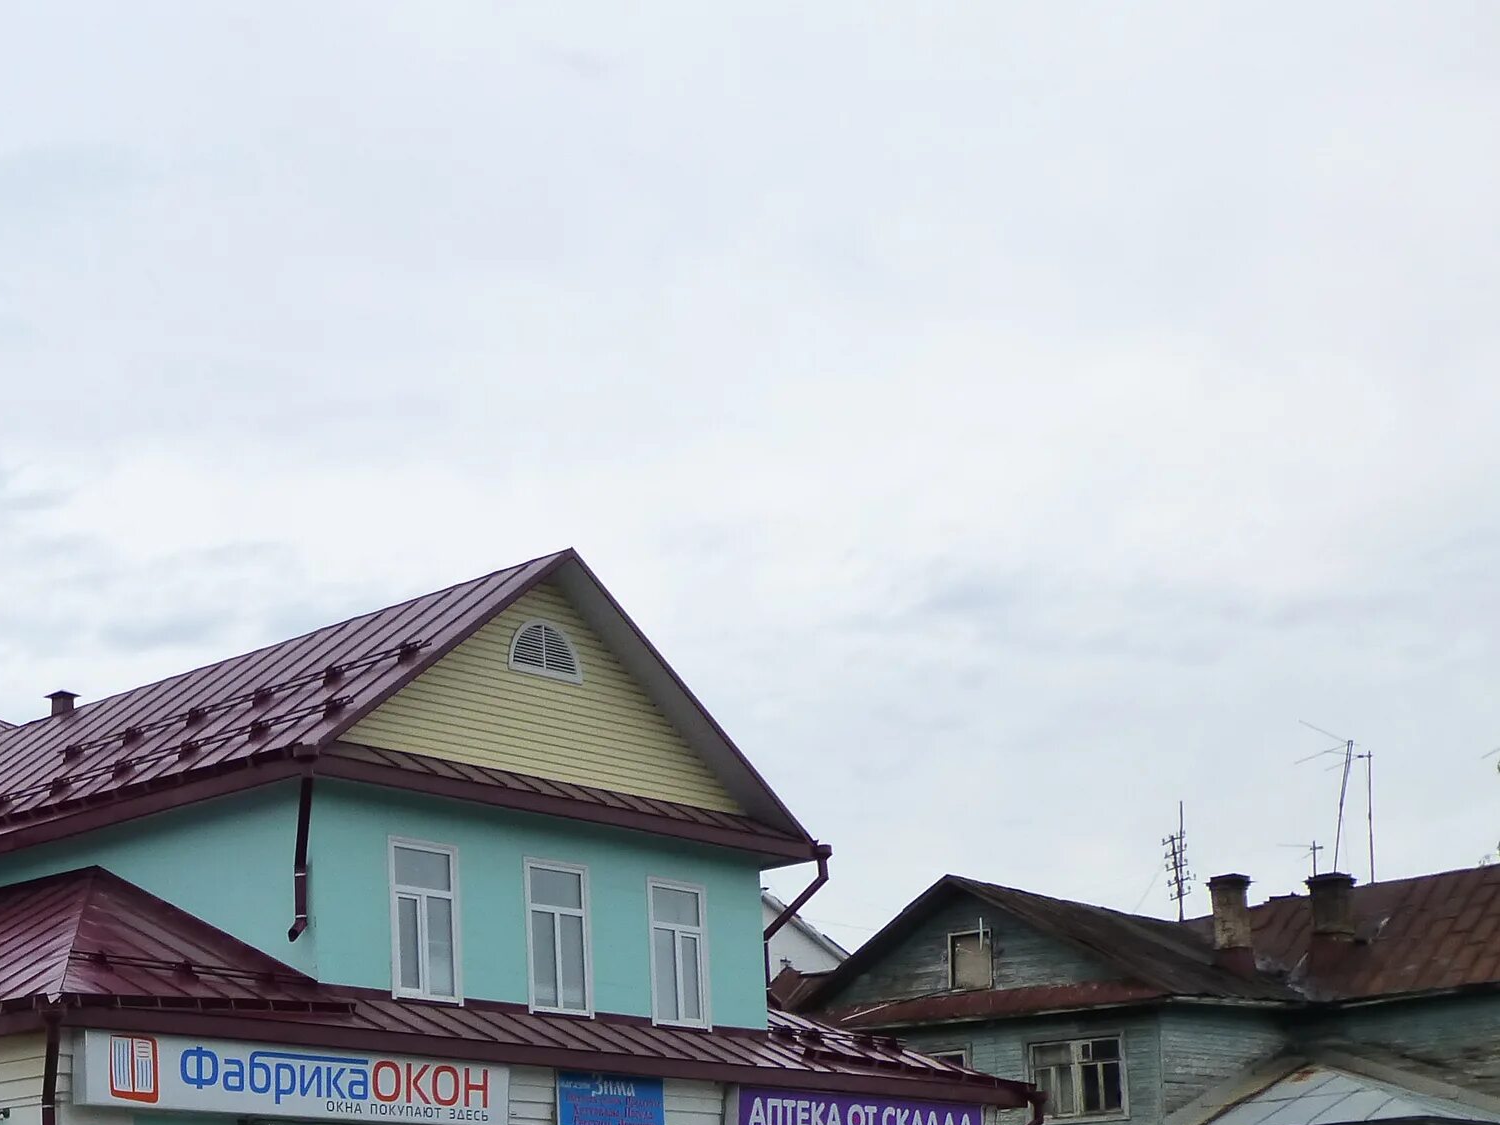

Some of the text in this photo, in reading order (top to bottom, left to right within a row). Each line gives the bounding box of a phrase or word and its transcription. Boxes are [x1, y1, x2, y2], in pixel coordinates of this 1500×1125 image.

[326, 1101, 490, 1122] ОКНА ПОКУПАЮТ ЗДЕСЬ
